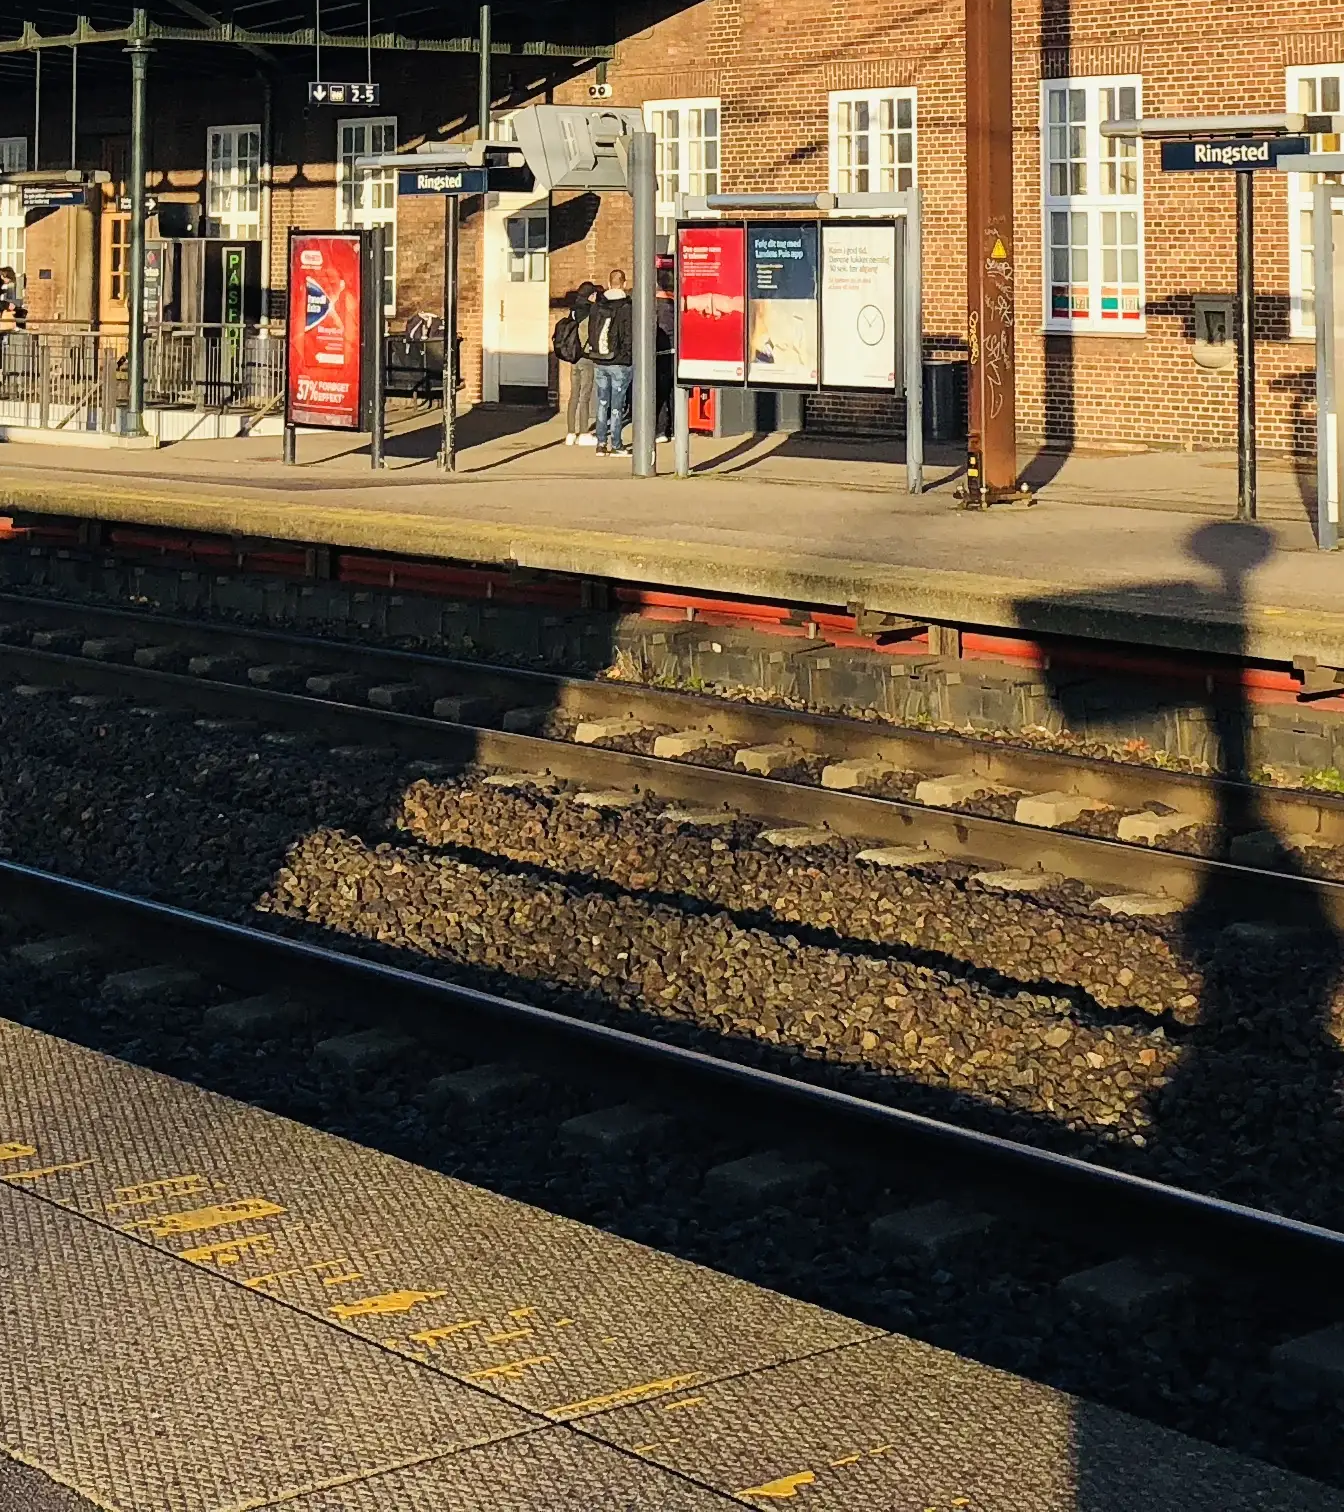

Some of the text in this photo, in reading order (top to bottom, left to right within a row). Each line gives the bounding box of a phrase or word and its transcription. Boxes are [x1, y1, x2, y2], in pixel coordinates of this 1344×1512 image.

[351, 89, 375, 103] 2-5
[1194, 141, 1269, 165] Ringsted
[417, 173, 462, 191] Ringsted
[227, 253, 240, 370] PASFO
